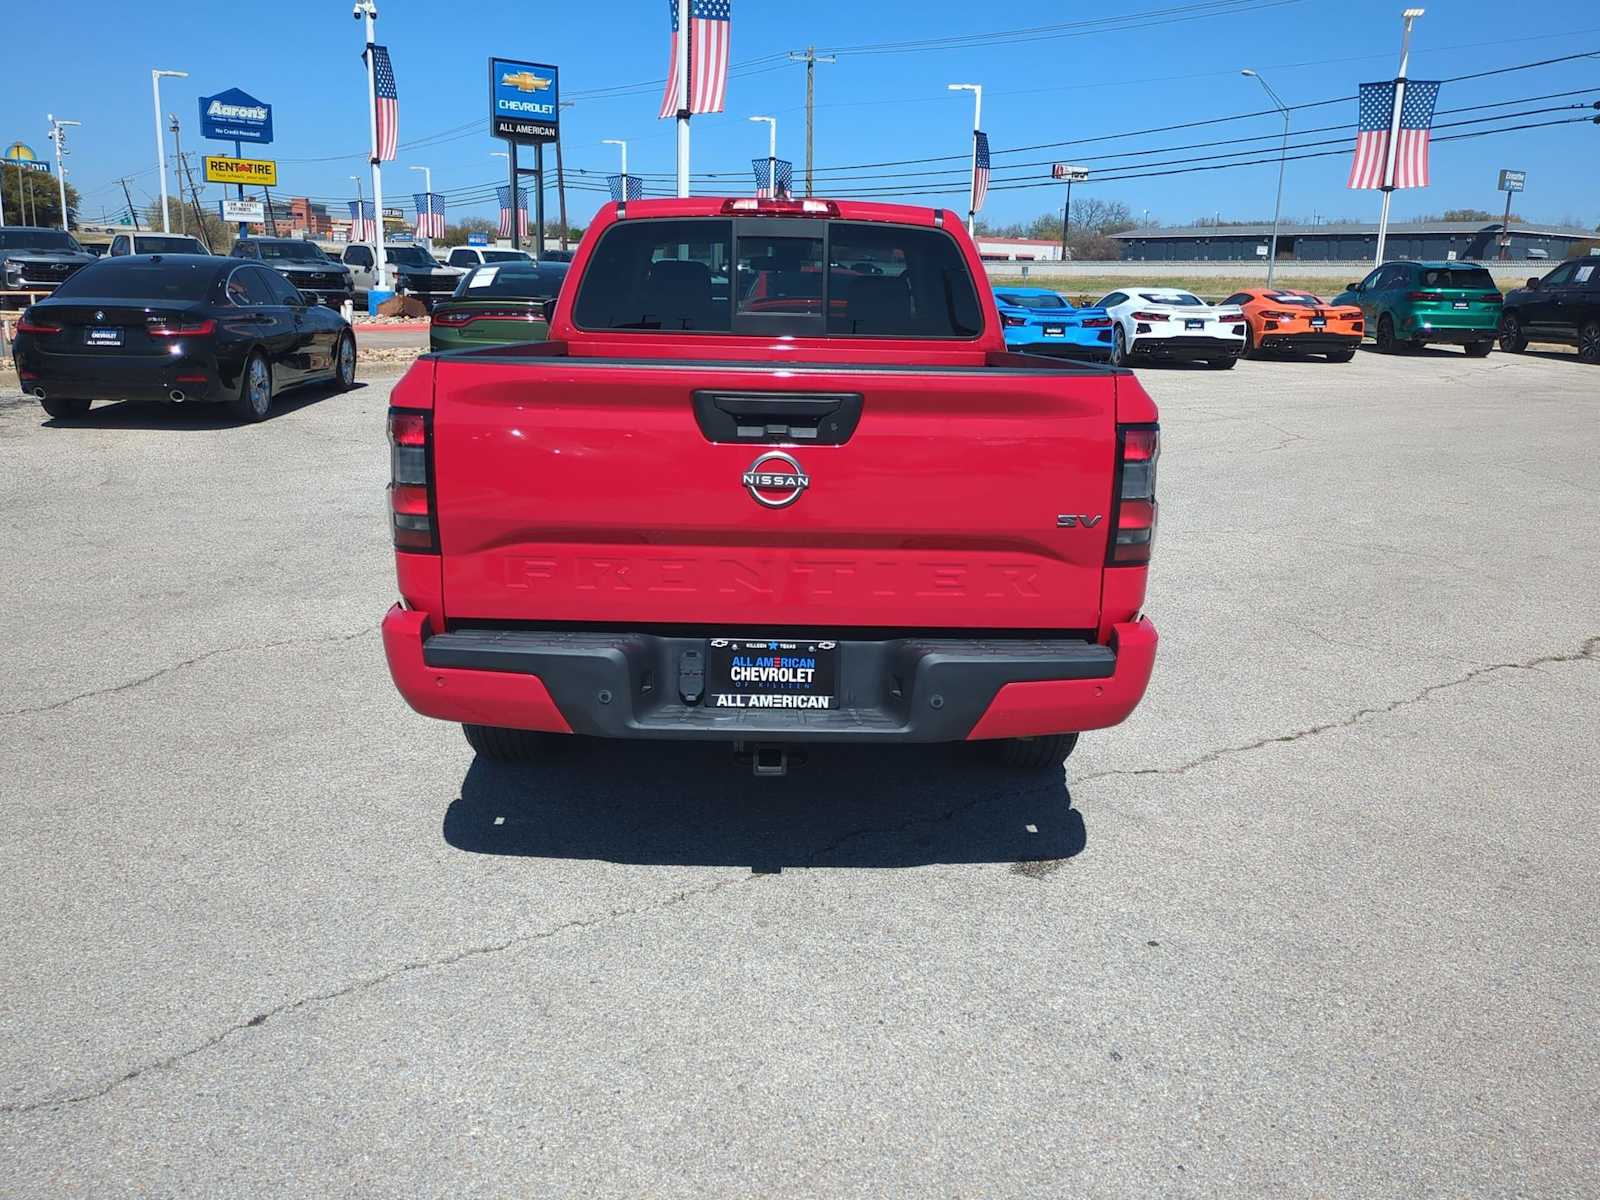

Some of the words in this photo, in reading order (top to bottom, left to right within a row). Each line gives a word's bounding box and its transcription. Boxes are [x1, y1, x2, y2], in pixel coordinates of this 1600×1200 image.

[207, 100, 268, 121] Aaron's
[499, 100, 554, 114] CHEVROLET
[499, 123, 514, 132] ALL
[516, 124, 555, 136] AMERICAN
[210, 160, 240, 172] RENT
[245, 163, 272, 175] TIRE
[743, 475, 809, 486] NISSAN
[1056, 513, 1102, 528] SV
[732, 656, 753, 667] ALL
[755, 656, 815, 668] AMERICAN
[730, 667, 815, 682] CHEVROLET
[716, 694, 745, 707] ALL
[748, 694, 829, 708] AMERICAN
